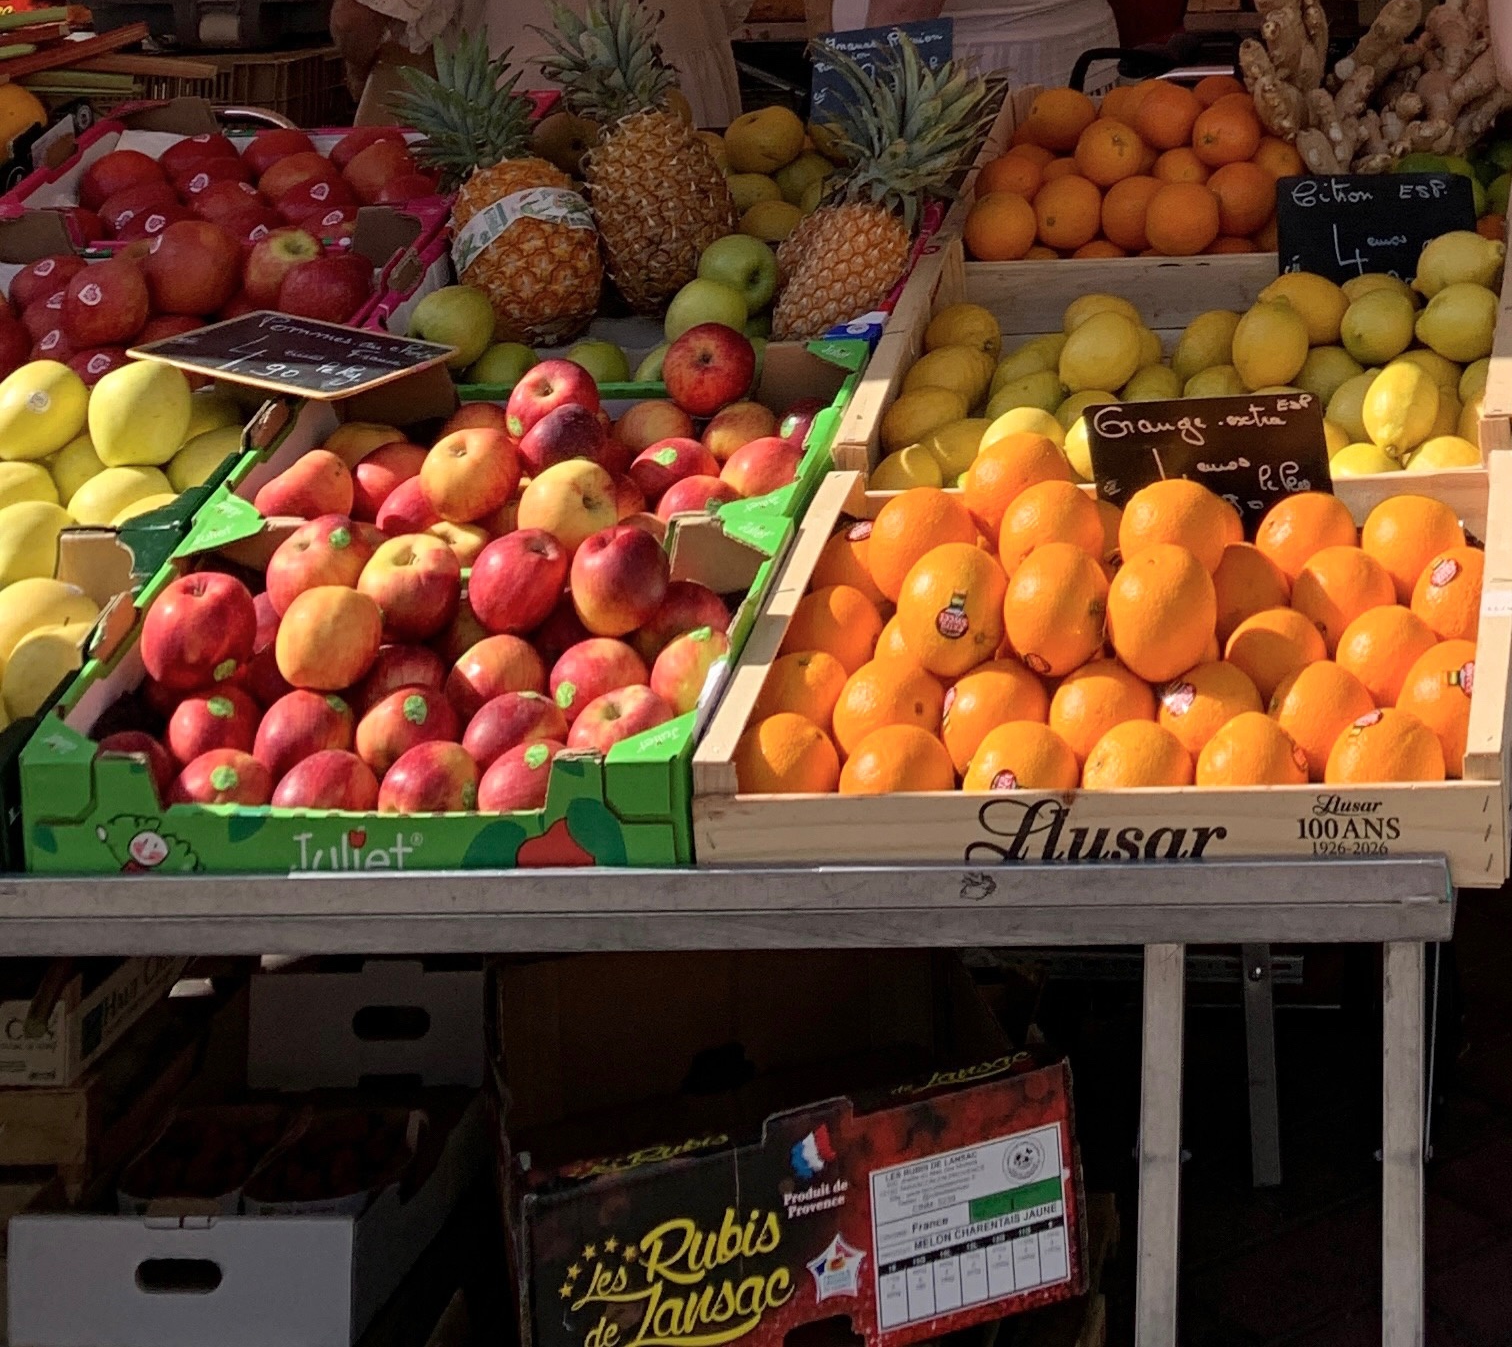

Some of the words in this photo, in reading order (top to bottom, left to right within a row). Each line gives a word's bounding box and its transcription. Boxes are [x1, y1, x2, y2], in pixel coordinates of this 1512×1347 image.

[963, 797, 1228, 861] Llusar
[1297, 816, 1340, 840] 100
[1341, 816, 1401, 840] ANS
[1311, 840, 1389, 857] 1926-2026
[783, 1183, 831, 1207] Produit
[832, 1177, 849, 1193] de
[787, 1195, 846, 1220] Provence
[911, 1217, 949, 1234] France
[913, 1232, 952, 1251] MELON
[954, 1215, 1021, 1240] CHARENTAIS
[1022, 1204, 1058, 1222] JAUNE
[638, 1206, 782, 1285] Rubis
